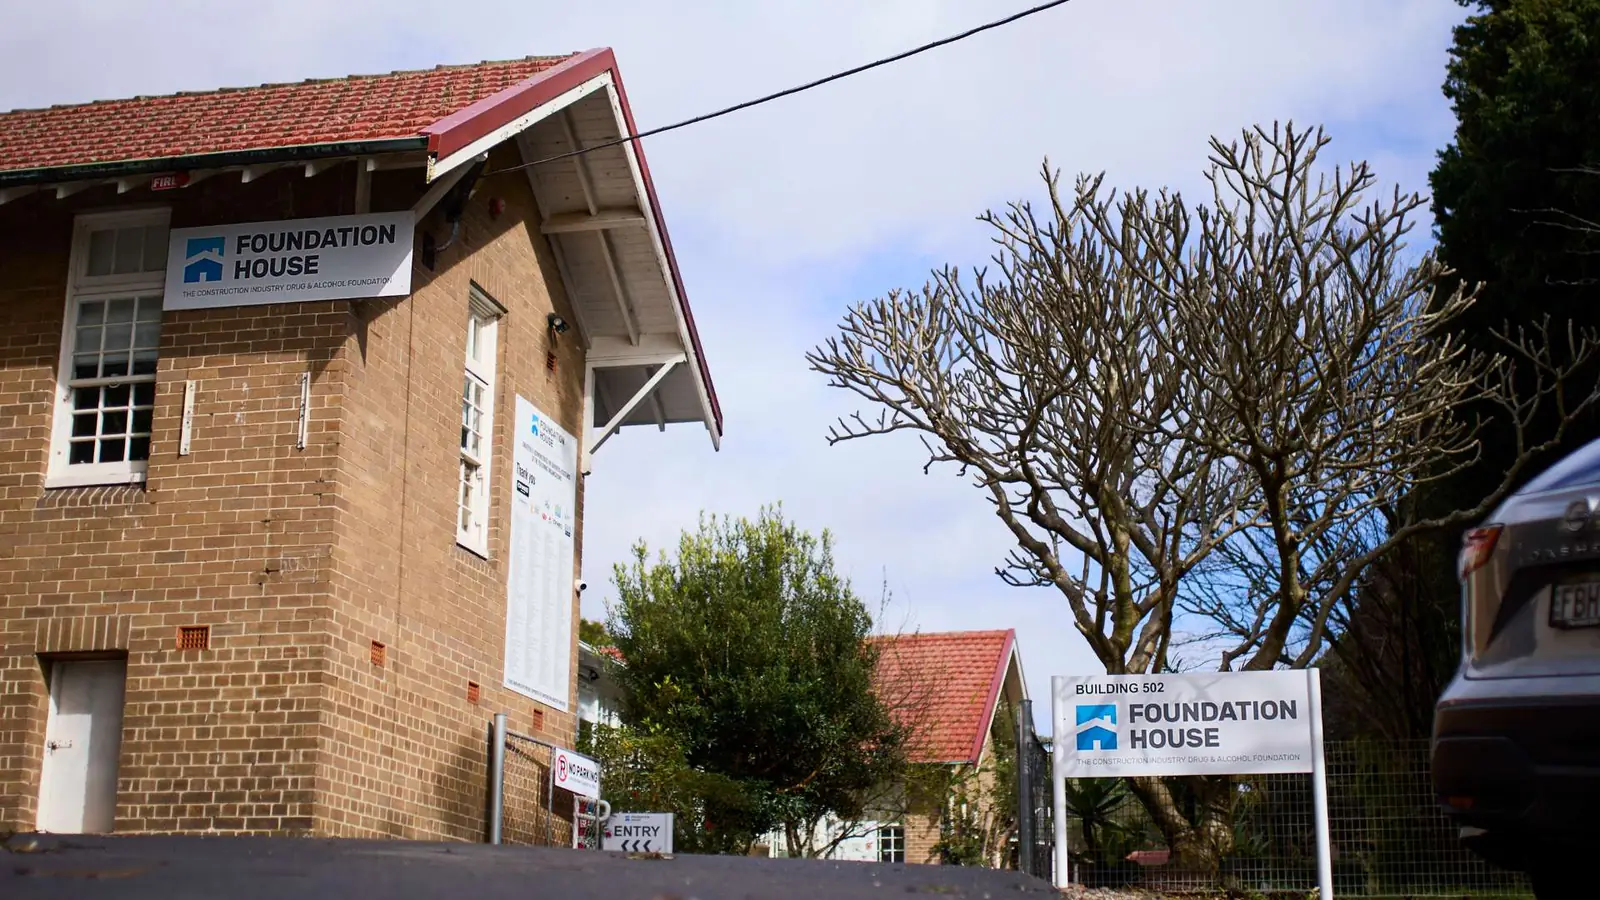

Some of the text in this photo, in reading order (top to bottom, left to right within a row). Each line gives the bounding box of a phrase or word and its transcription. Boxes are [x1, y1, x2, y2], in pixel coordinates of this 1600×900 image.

[235, 223, 396, 254] FOUNDATION
[233, 254, 320, 280] HOUSE
[182, 290, 196, 298] THE
[197, 287, 249, 297] CONSTRUCTION
[250, 284, 284, 293] INDUSTRY
[286, 282, 306, 291] DRUG
[313, 279, 346, 289] ALCOHOL
[347, 276, 393, 287] FOUNDATION
[539, 431, 554, 448] HOUSE
[516, 461, 528, 480] Thank
[528, 472, 536, 485] you
[1075, 682, 1165, 695] BUILDING 502
[1129, 699, 1298, 724] FOUNDATION
[1130, 728, 1220, 749] HOUSE
[1092, 757, 1149, 766] CONSTRUCTION
[1149, 756, 1186, 764] INDUSTRY
[1188, 755, 1209, 763] DRUG
[1216, 755, 1251, 763] ALCOHOL
[1253, 753, 1300, 762] FOUNDATION
[568, 763, 576, 775] NO
[576, 765, 598, 783] PARKING
[614, 825, 661, 838] ENTRY
